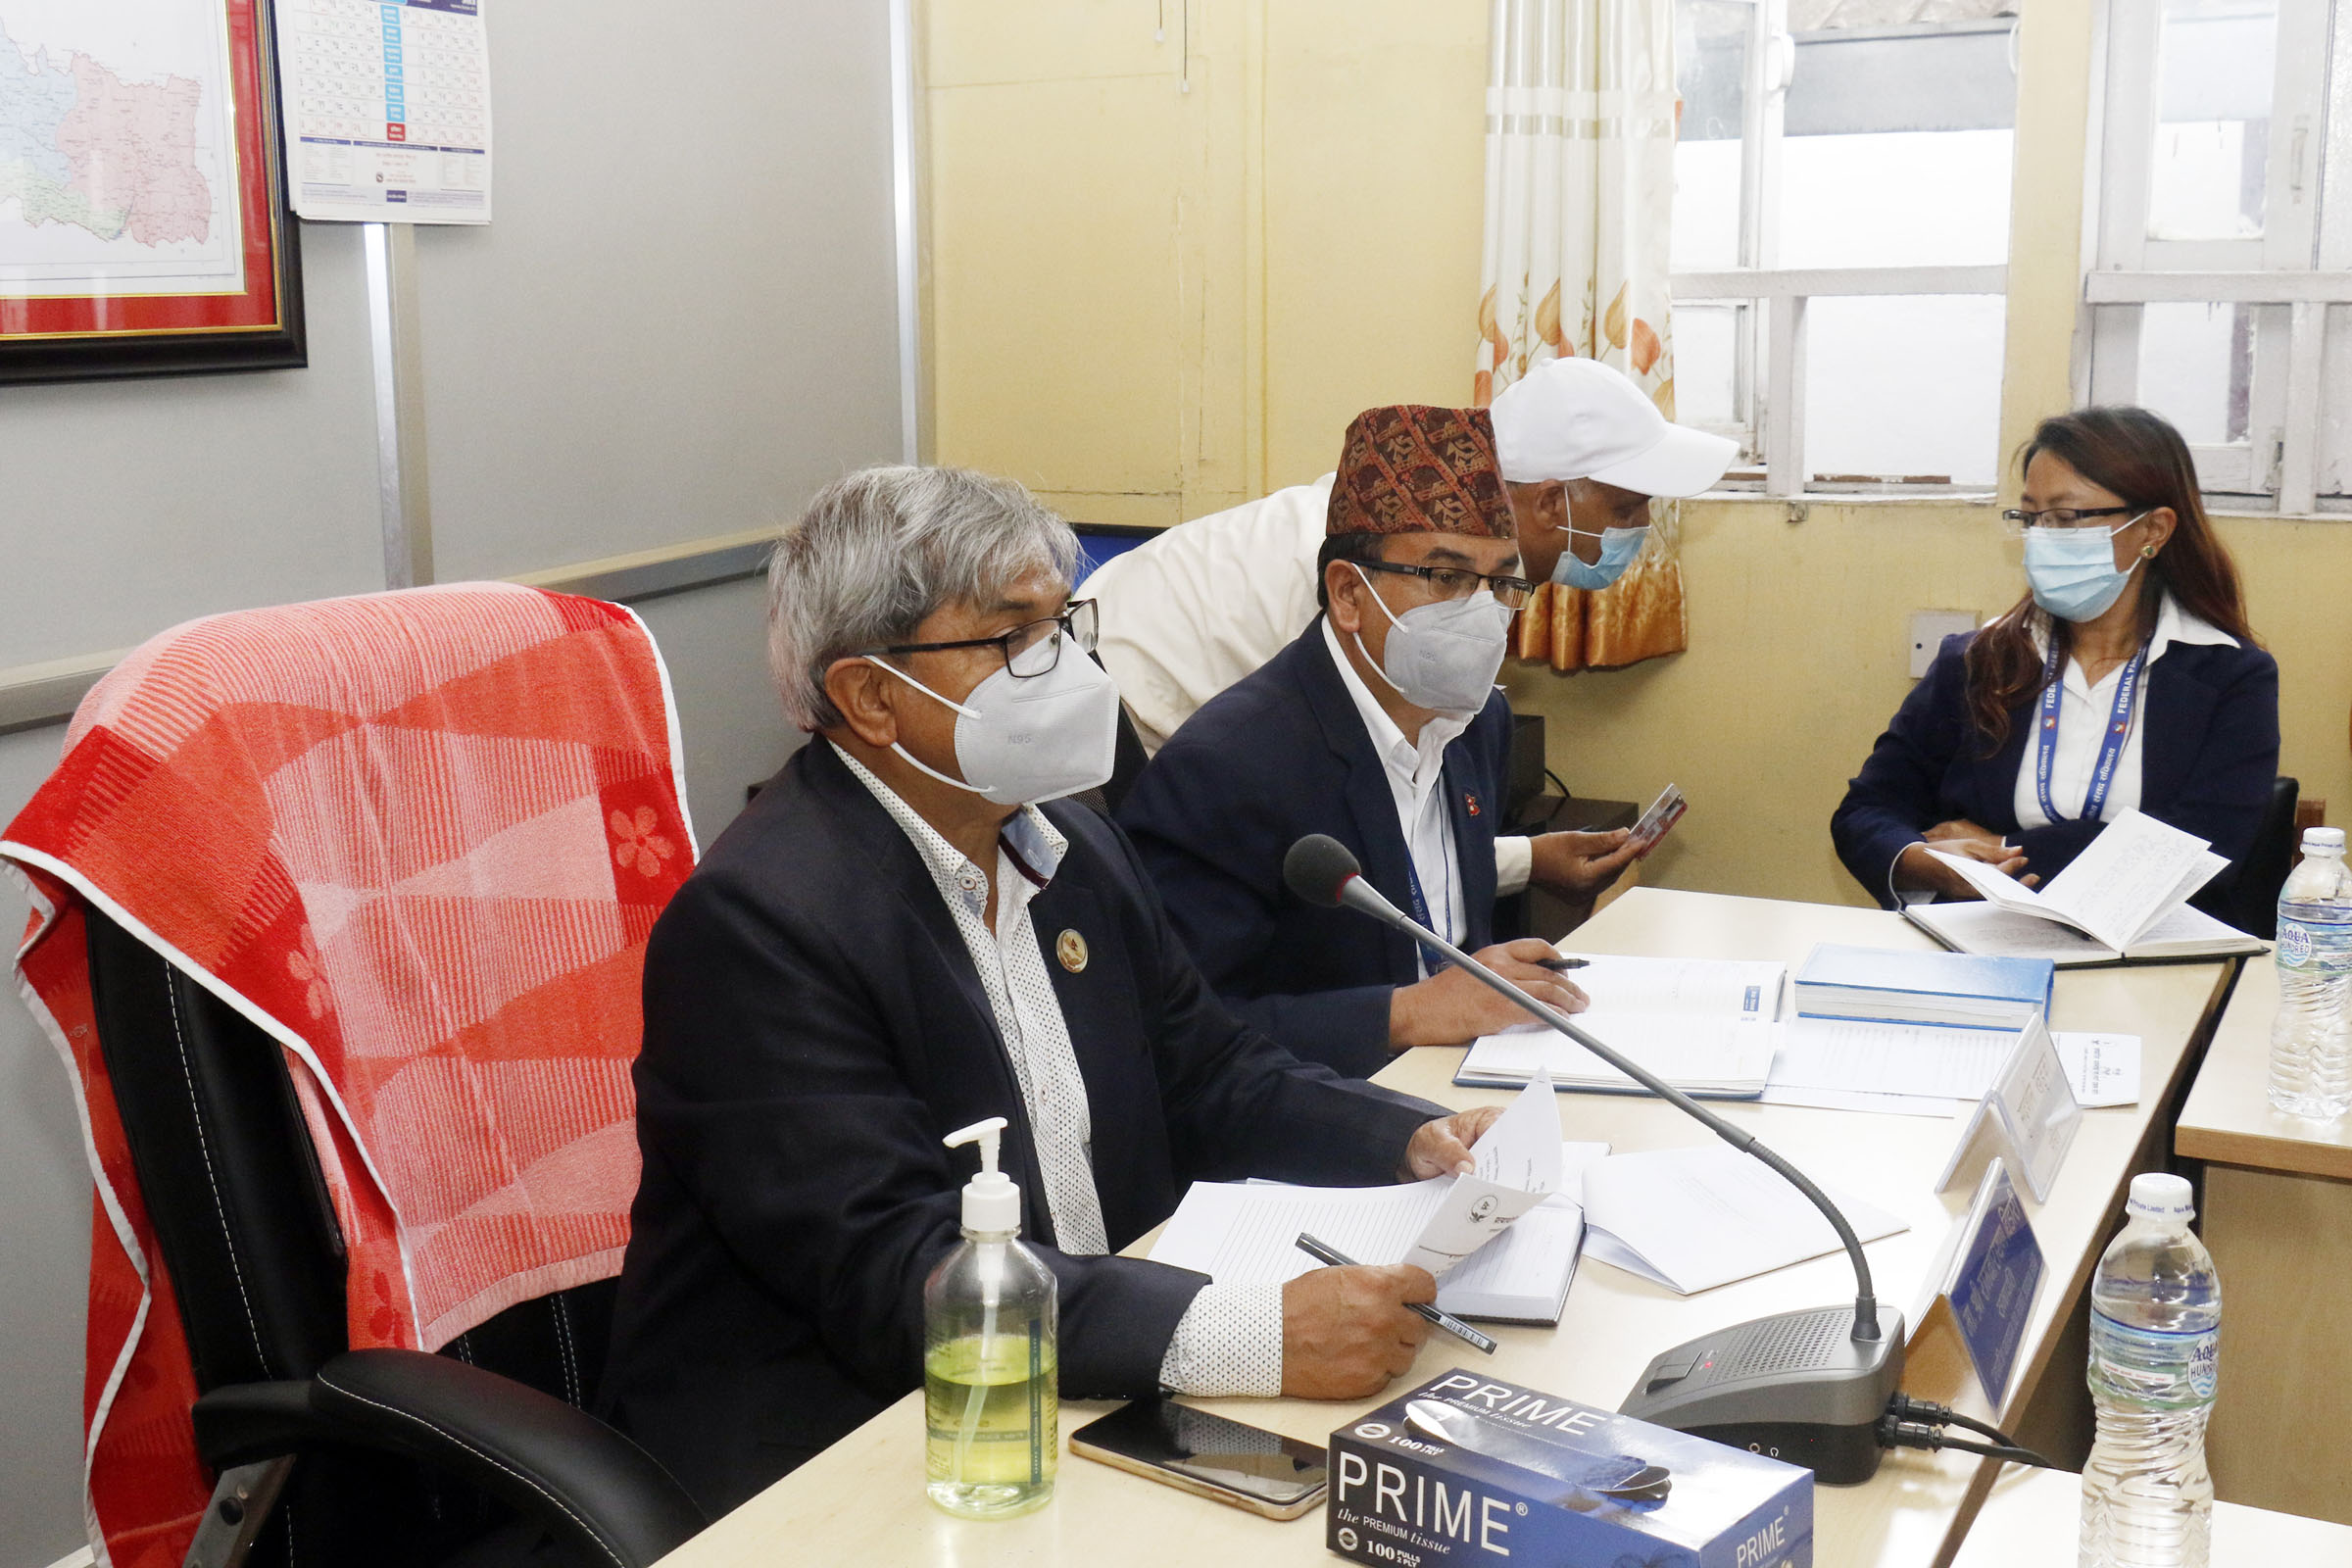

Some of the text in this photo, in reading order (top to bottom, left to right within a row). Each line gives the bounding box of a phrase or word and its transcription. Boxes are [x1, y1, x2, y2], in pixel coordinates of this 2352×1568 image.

[2045, 681, 2057, 709] FEDER
[2117, 674, 2133, 713] FEDERAL
[1007, 733, 1032, 745] N95
[2280, 928, 2310, 943] AQUA
[1430, 1375, 1606, 1436] PRIME
[1444, 1397, 1491, 1415] PREMIUM
[1388, 1436, 1423, 1450] 100
[1337, 1508, 1451, 1554] the PREMIUM tissue
[1367, 1540, 1396, 1560] 100
[1737, 1515, 1786, 1568] PRIME
[1396, 1549, 1421, 1563] PULLS
[1402, 1558, 1418, 1568] PLY
